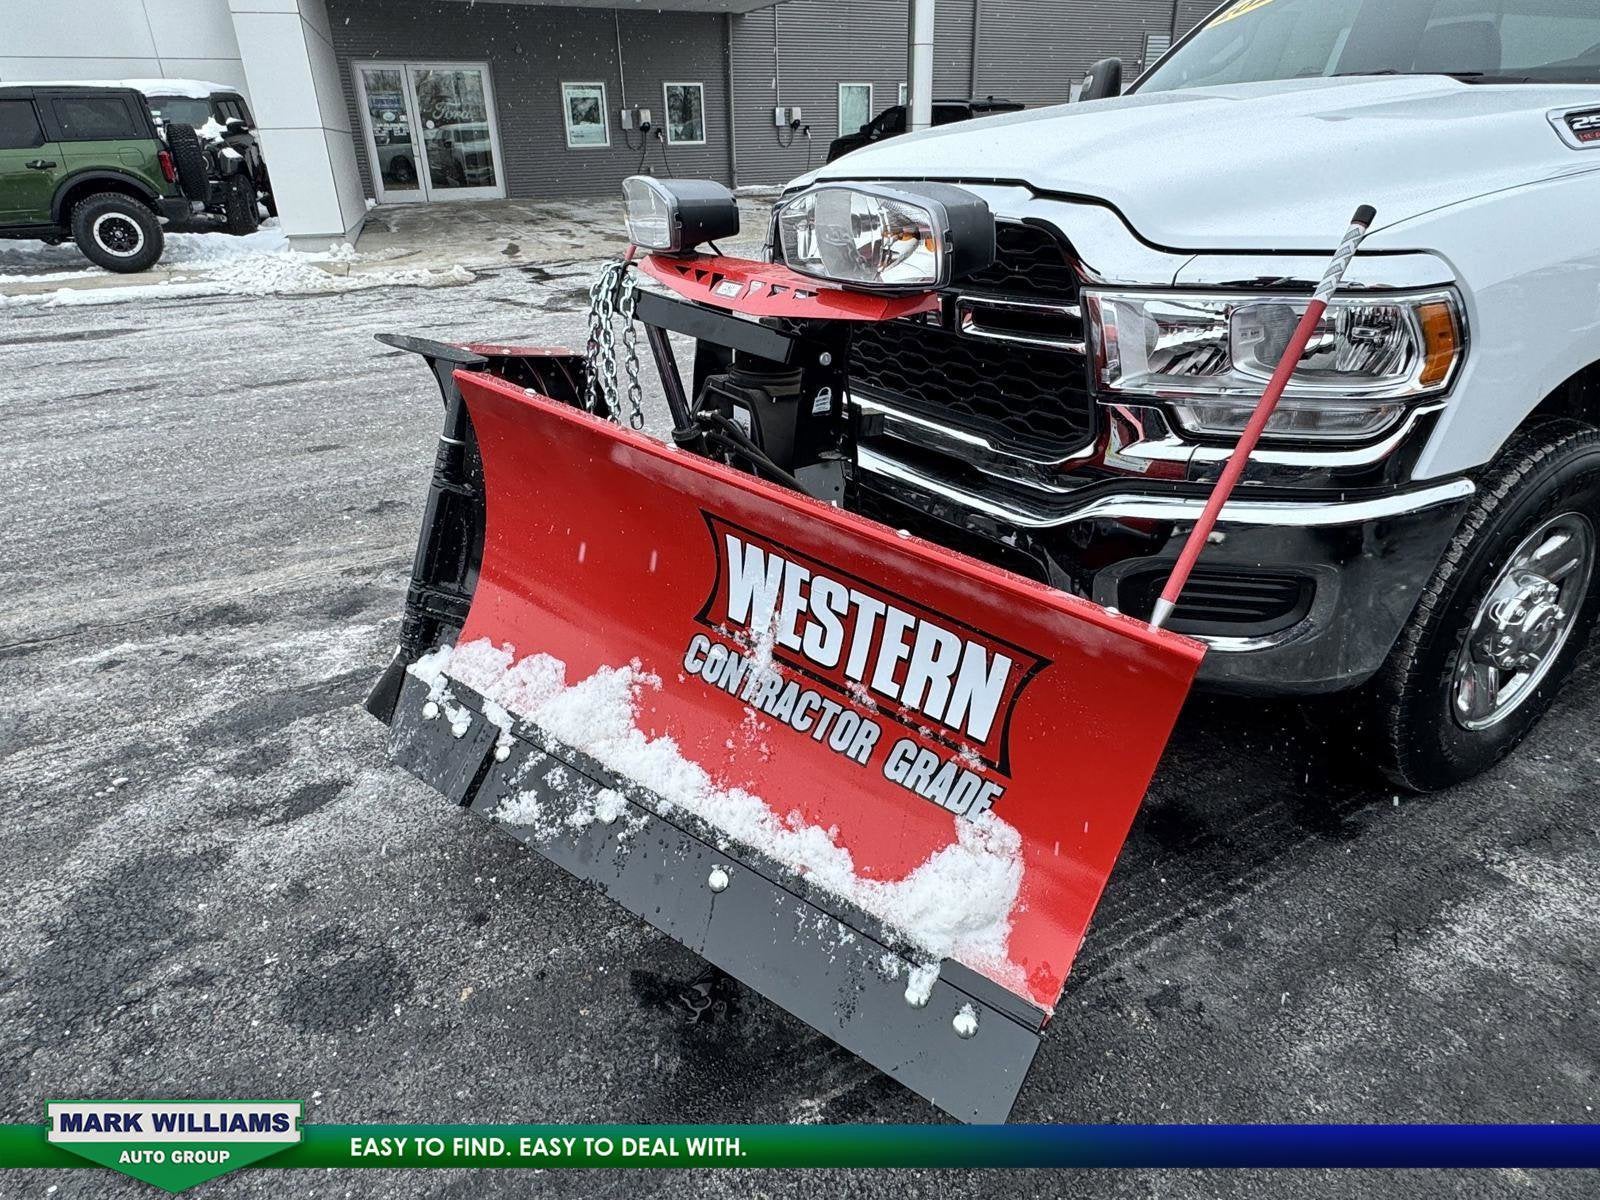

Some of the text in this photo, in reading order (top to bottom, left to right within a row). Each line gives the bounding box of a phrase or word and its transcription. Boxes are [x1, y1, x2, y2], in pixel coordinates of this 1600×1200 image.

[683, 633, 1007, 822] CONTRACTOR GRADE
[725, 533, 1012, 744] WESTERN
